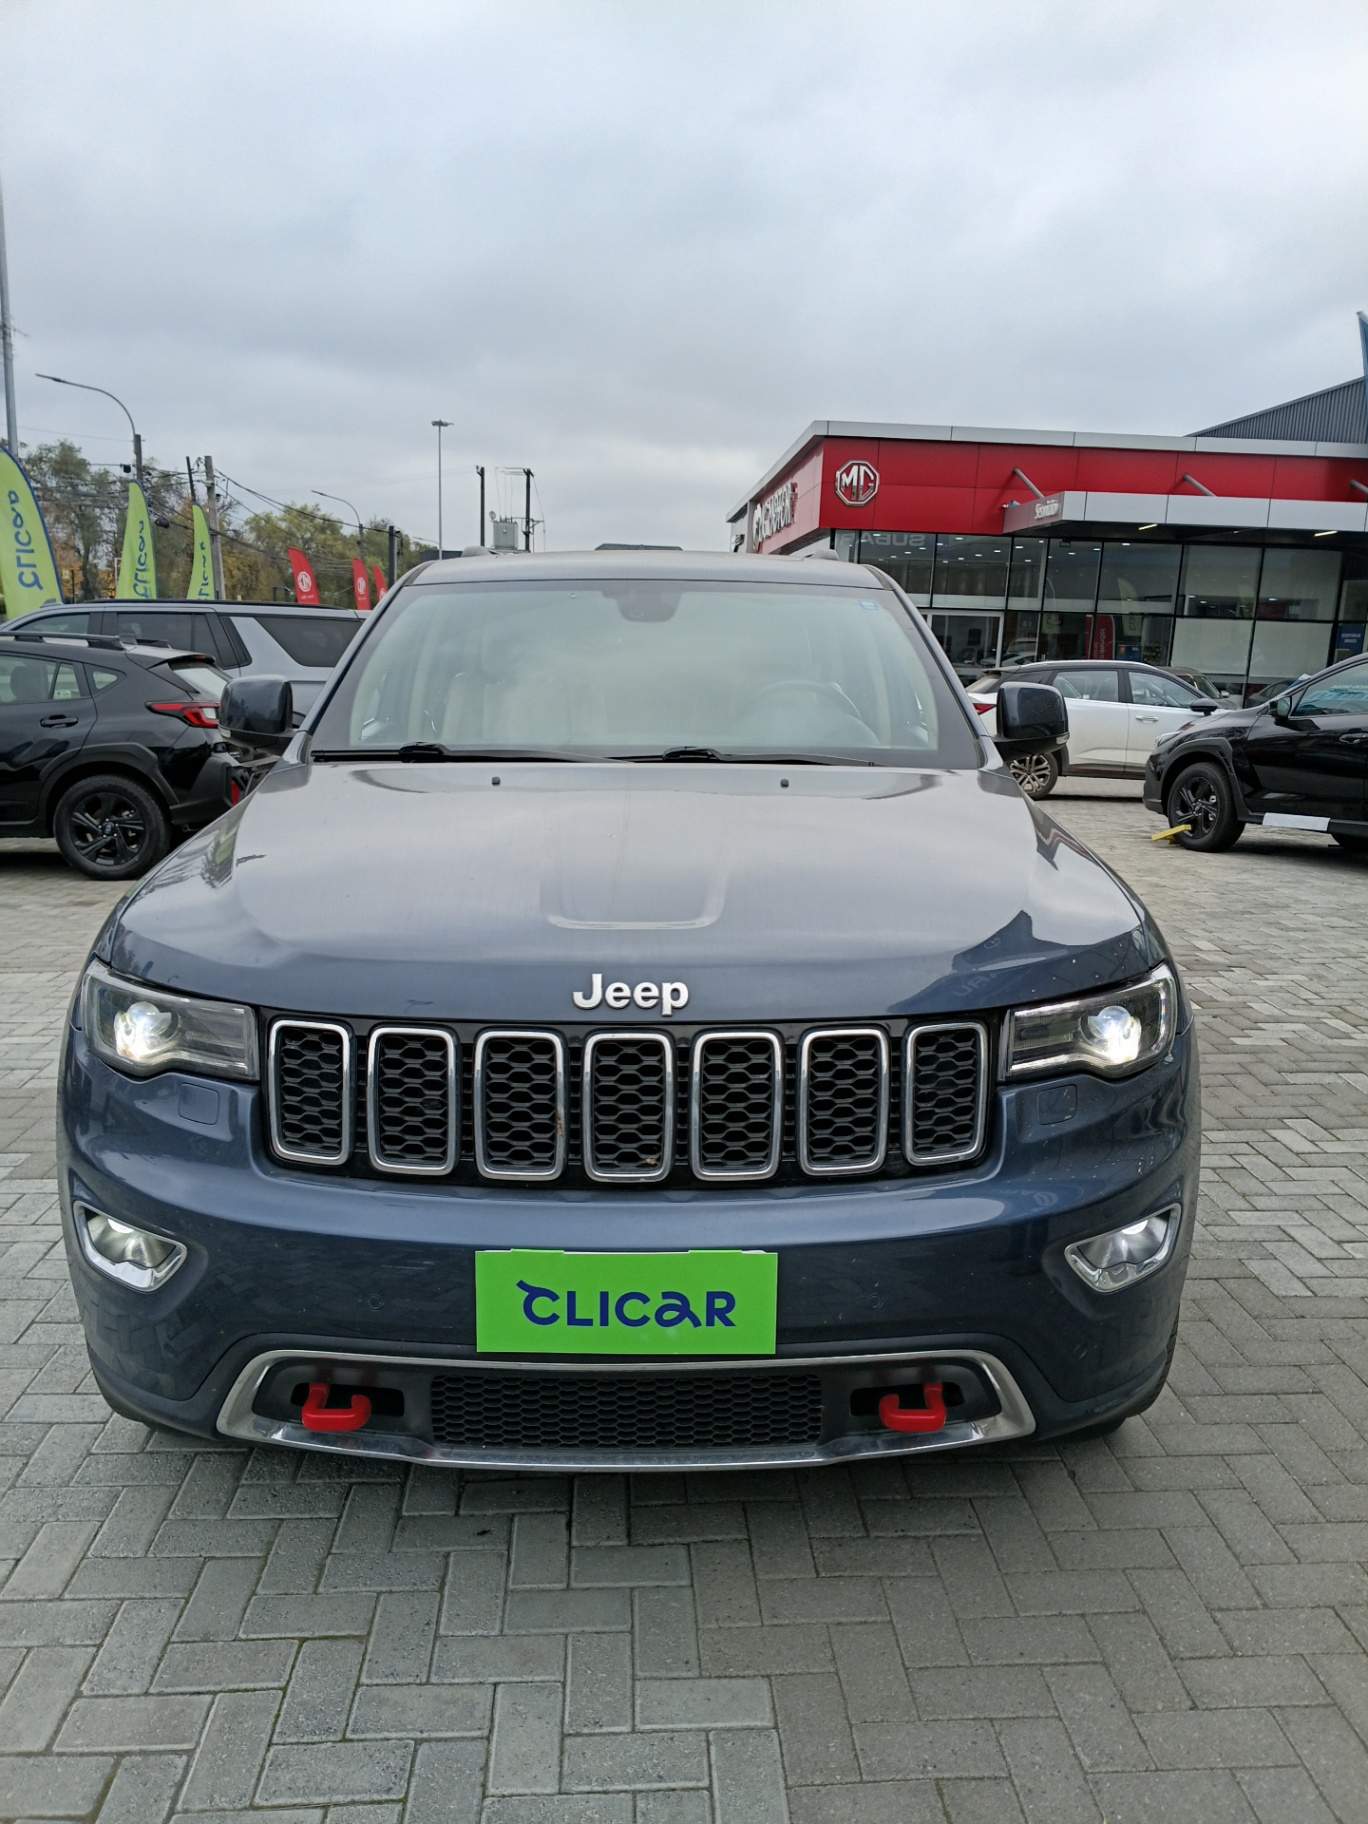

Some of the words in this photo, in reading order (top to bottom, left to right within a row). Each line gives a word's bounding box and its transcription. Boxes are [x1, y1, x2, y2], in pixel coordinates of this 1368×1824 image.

[839, 462, 876, 501] MG
[573, 974, 689, 1015] Jeep
[516, 1280, 736, 1328] CLICAR
